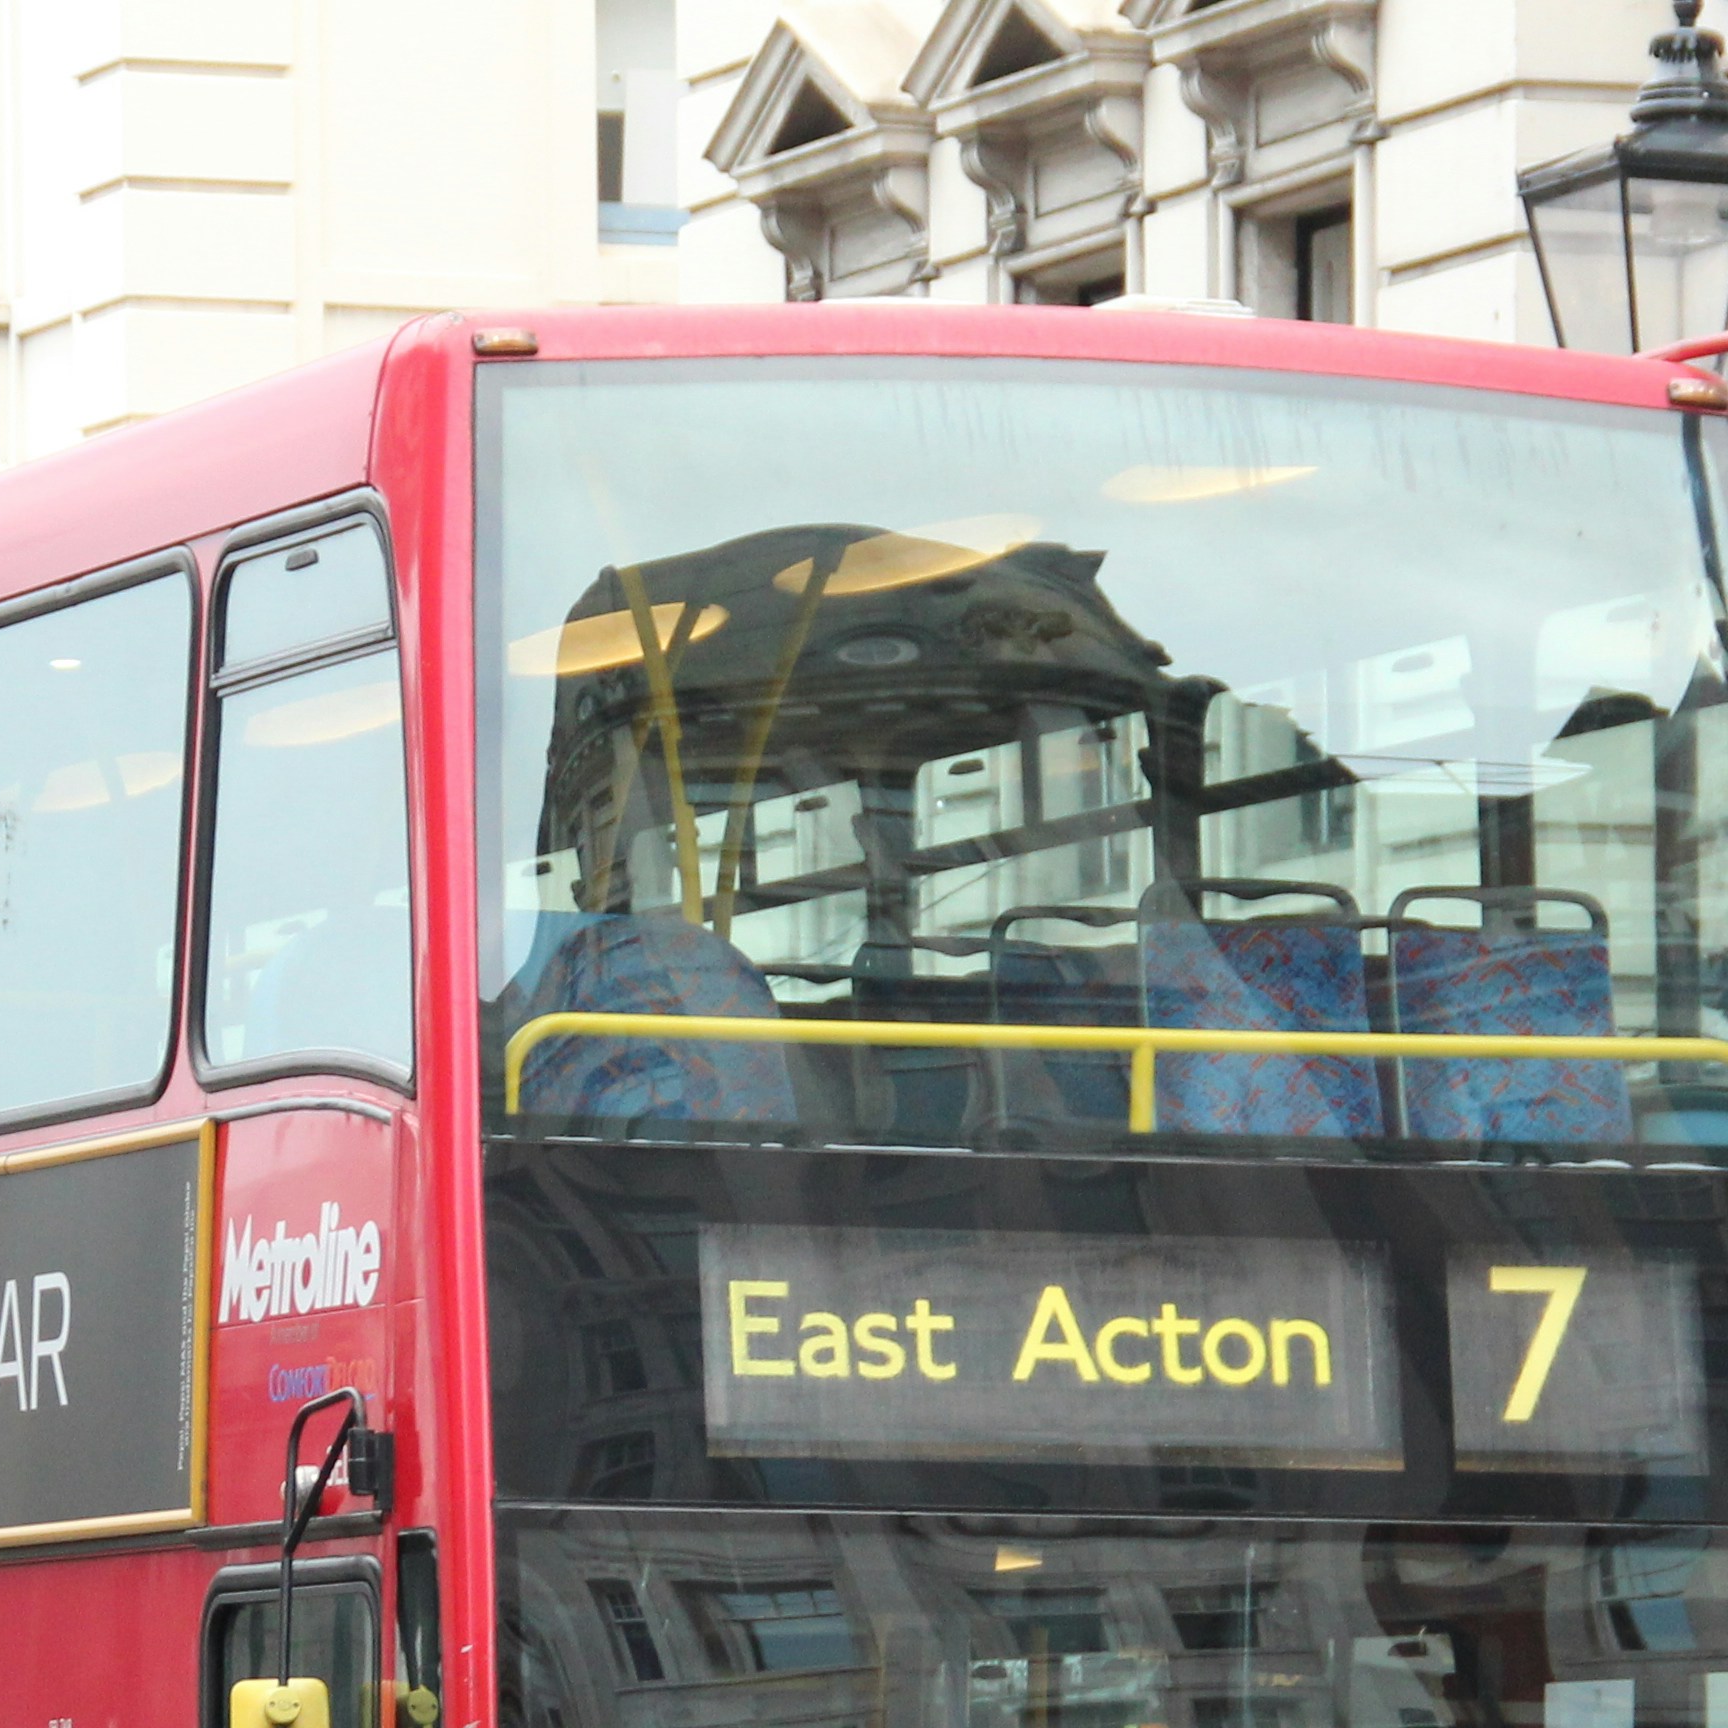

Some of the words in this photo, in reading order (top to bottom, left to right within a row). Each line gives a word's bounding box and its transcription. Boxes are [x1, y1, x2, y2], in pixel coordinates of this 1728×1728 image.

[218, 1201, 381, 1324] Metroline
[728, 1279, 958, 1382] East
[1012, 1284, 1333, 1388] Acton
[1489, 1265, 1589, 1423] 7
